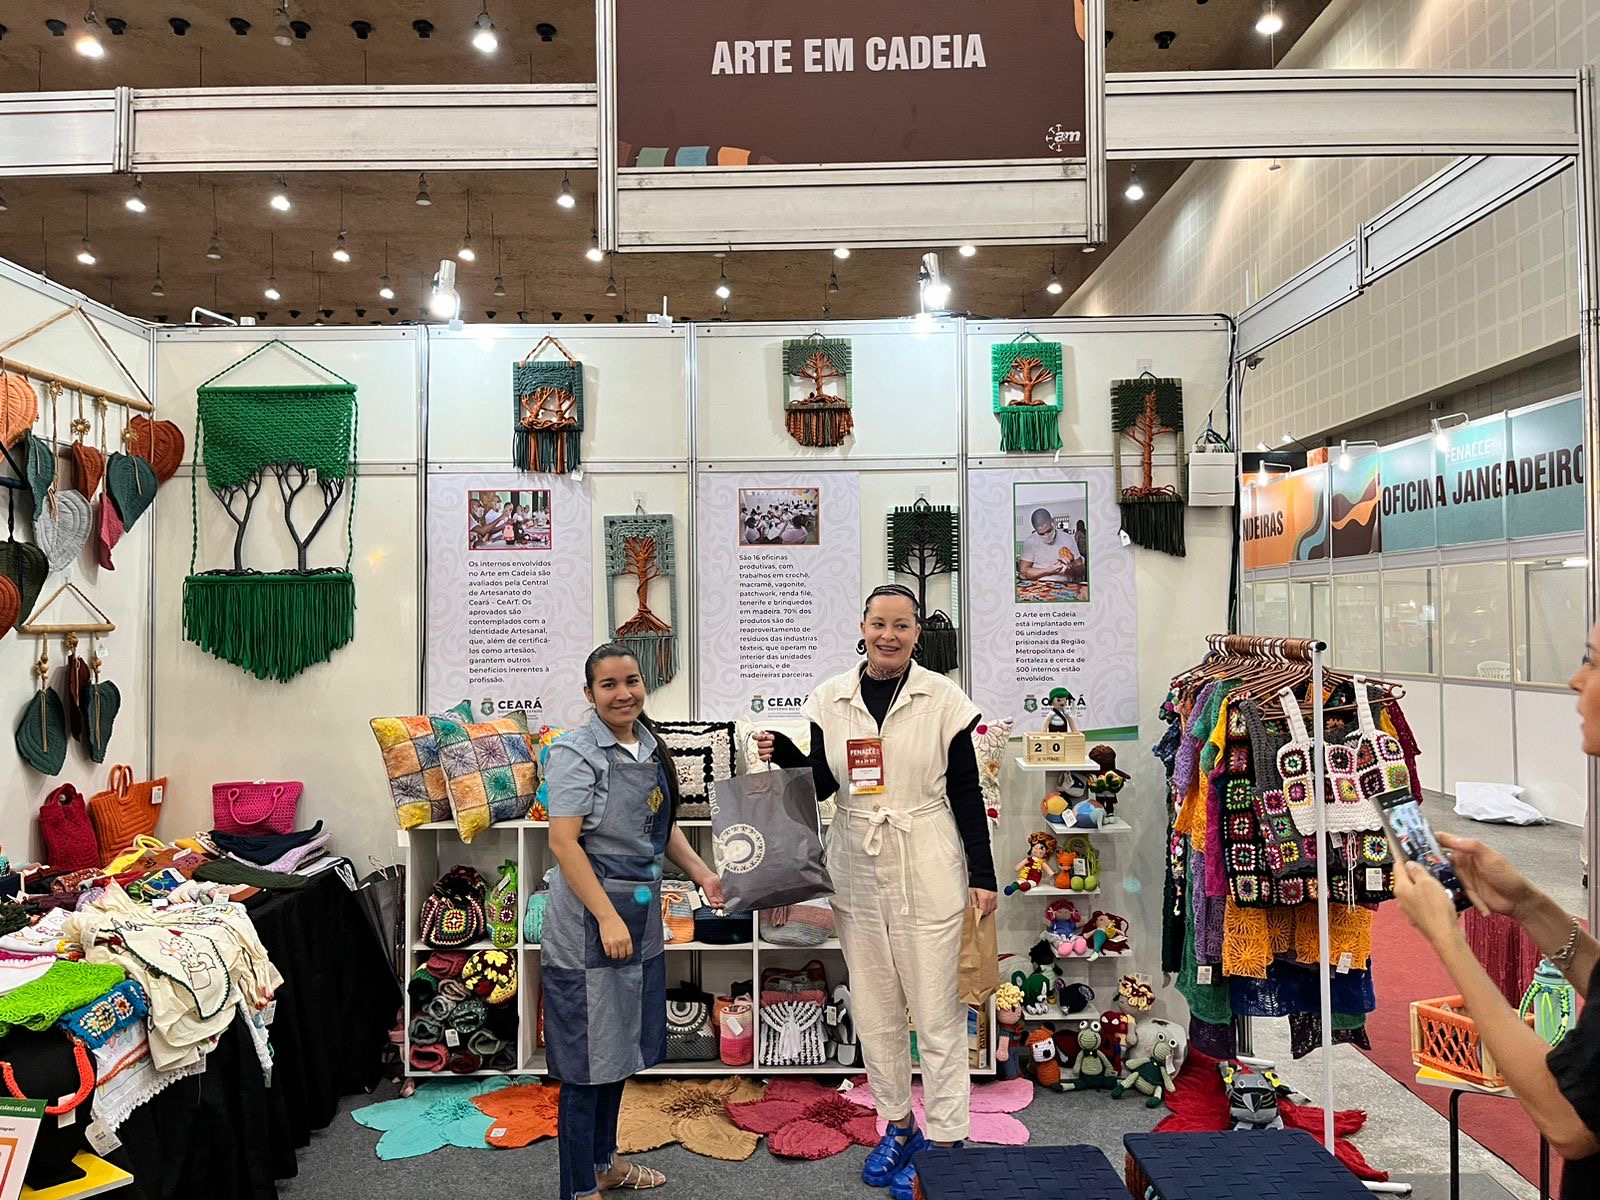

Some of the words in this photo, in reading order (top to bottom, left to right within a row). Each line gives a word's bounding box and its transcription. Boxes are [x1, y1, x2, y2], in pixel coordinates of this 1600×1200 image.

[711, 39, 793, 75] ARTE
[804, 37, 854, 73] EM
[865, 34, 987, 71] CADEIA
[1382, 475, 1447, 518] OFICINA
[498, 697, 542, 709] CEARÁ
[1034, 743, 1042, 752] 2
[1052, 743, 1060, 752] 0
